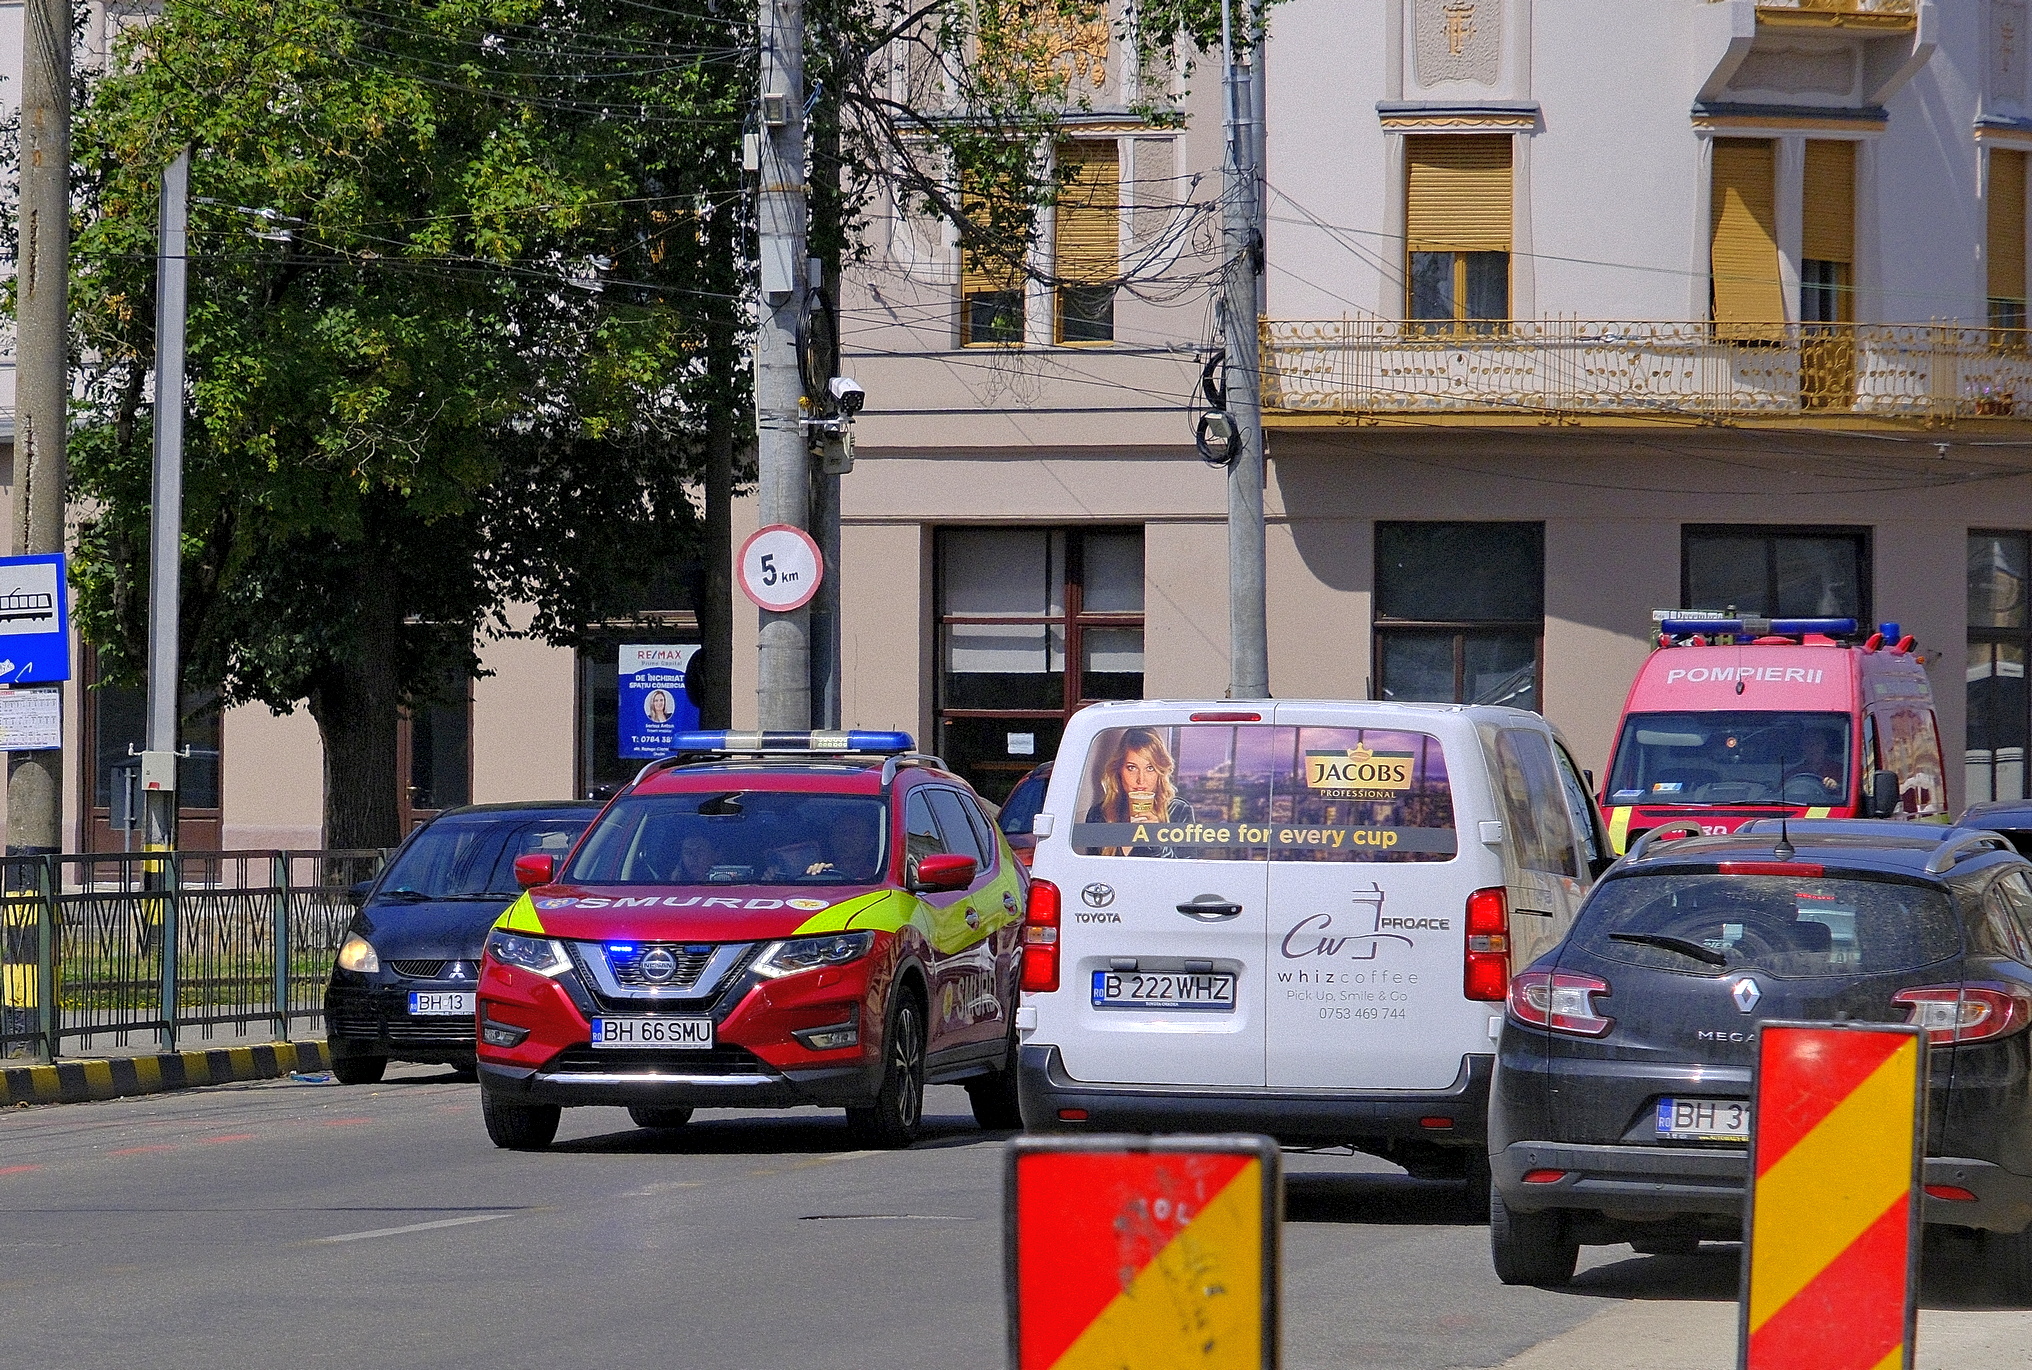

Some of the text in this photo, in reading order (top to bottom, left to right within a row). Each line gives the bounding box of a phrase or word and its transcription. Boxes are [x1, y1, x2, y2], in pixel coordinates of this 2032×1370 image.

[760, 553, 799, 586] 5 km
[637, 650, 682, 660] RE/MAX
[635, 673, 686, 682] DE ÎNCHIRIAT
[1666, 667, 1823, 684] POMPIERII
[1312, 763, 1405, 784] JACOBS
[1320, 789, 1397, 799] PROFESSIONAL
[1131, 824, 1398, 849] A coffee for every cup
[575, 896, 785, 910] SMURD
[1074, 913, 1122, 924] TOYOTA
[1381, 917, 1451, 931] PROACE
[642, 961, 674, 970] NISSAN
[1093, 975, 1229, 1000] RO B 222 WHZ
[419, 995, 441, 1010] BH
[448, 994, 463, 1010] 13
[1286, 990, 1312, 1001] Pick
[1340, 990, 1375, 1001] Smile
[1378, 991, 1387, 1001] &
[1389, 991, 1408, 1001] Co
[1319, 1007, 1406, 1019] 0753 469 744
[592, 1021, 710, 1041] RO BH 66 SMU
[1658, 1102, 1752, 1130] RO BH 3
